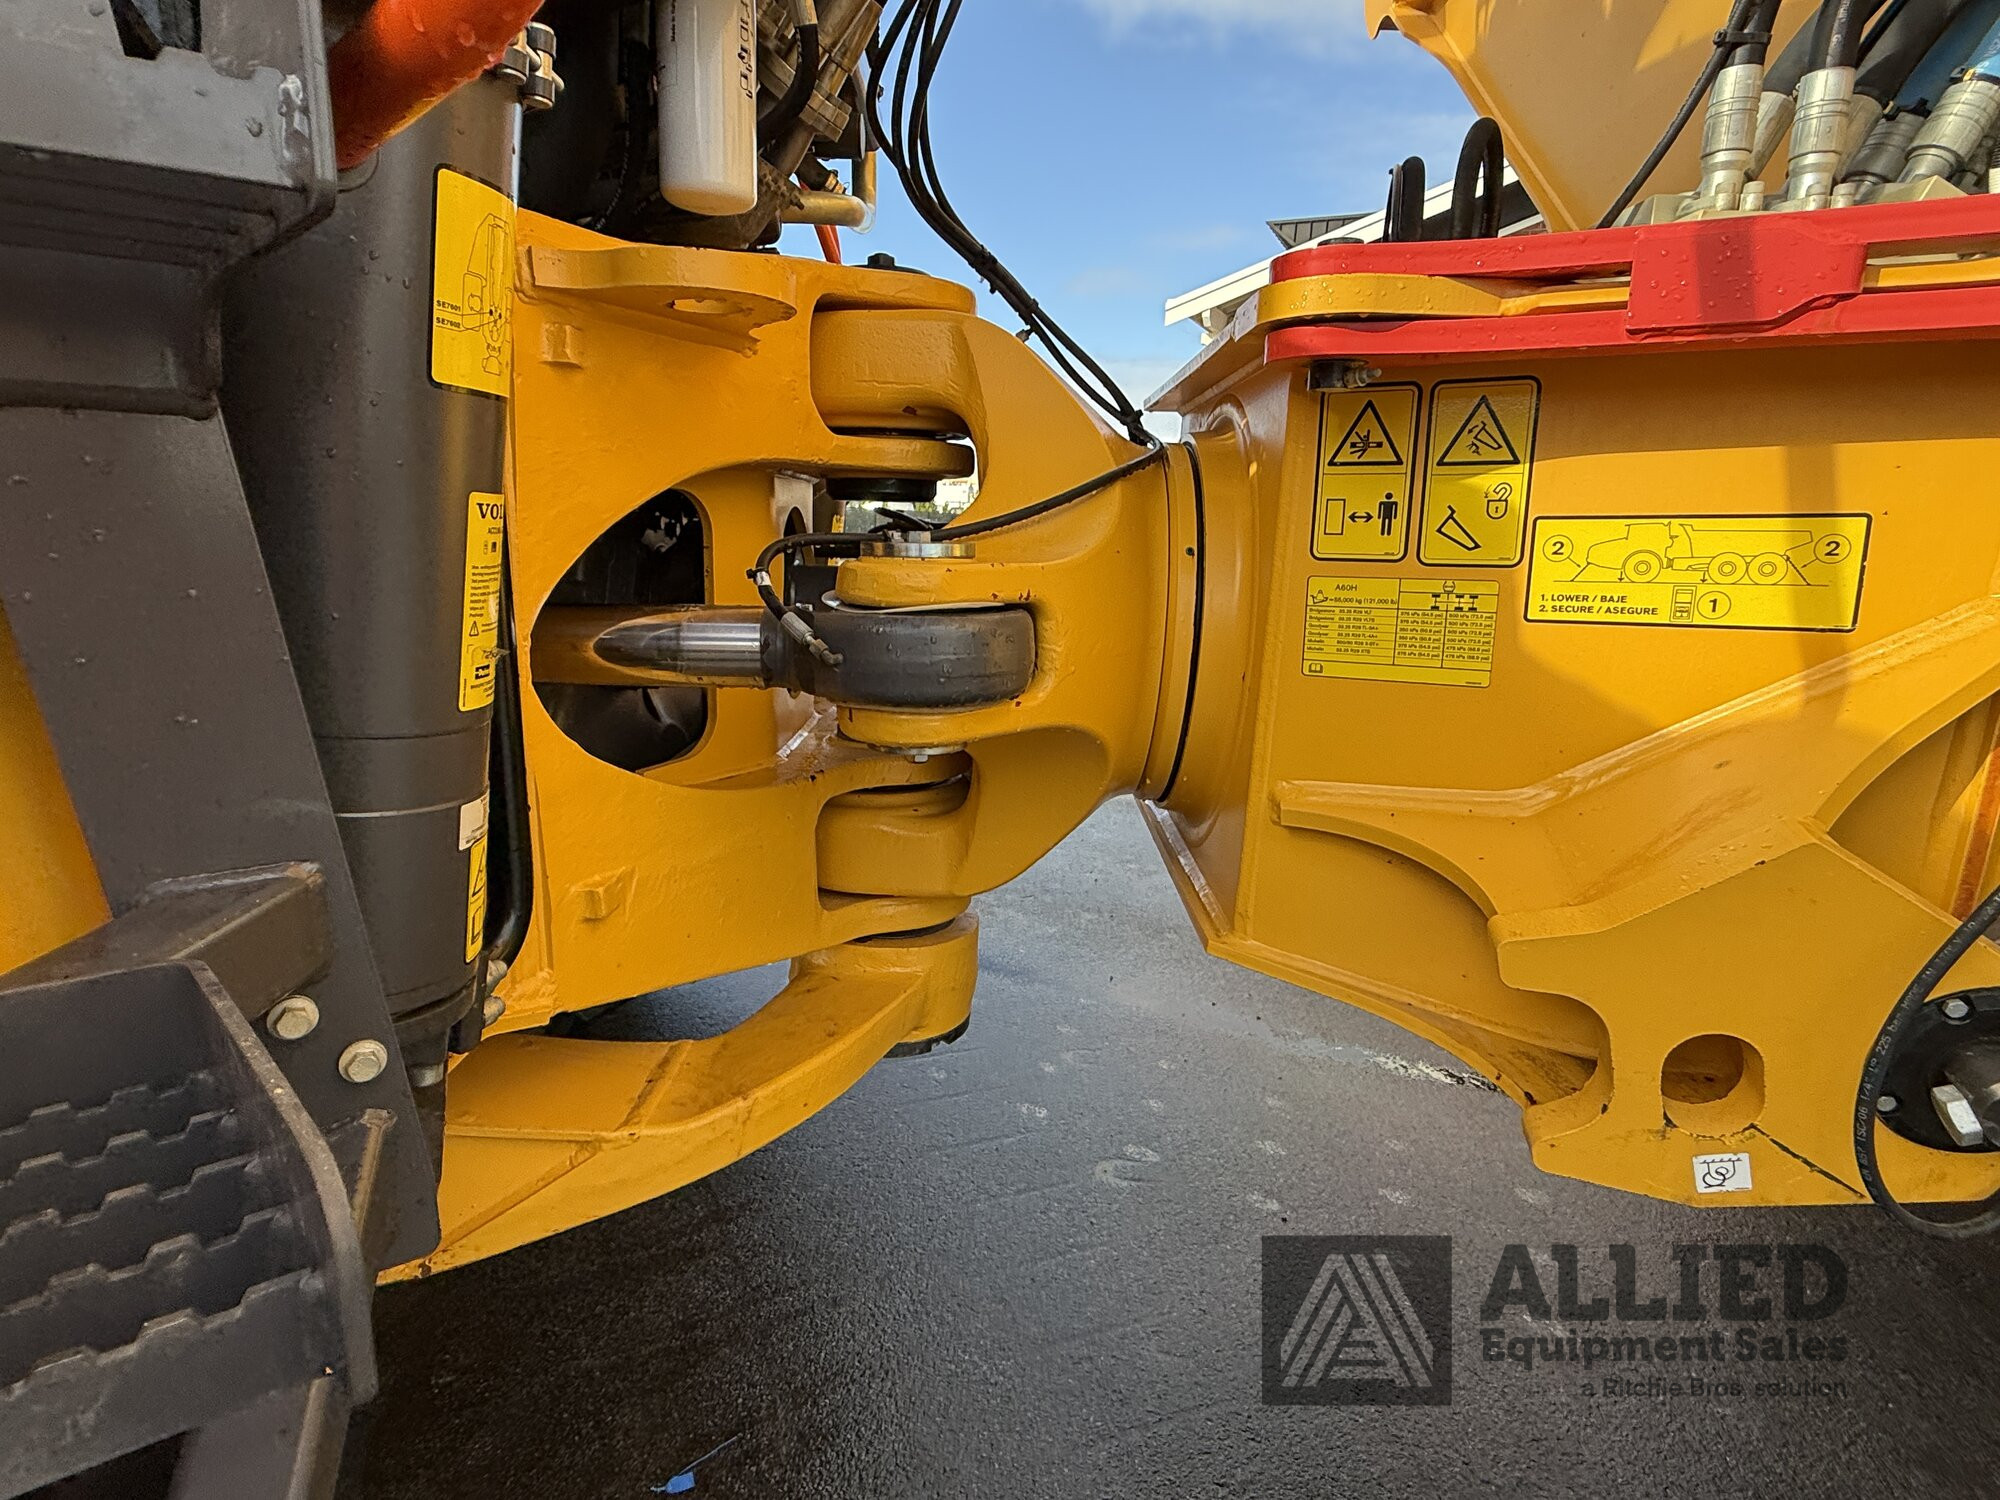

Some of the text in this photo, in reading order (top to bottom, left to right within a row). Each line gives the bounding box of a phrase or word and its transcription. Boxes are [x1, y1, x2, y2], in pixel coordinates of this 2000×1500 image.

[1552, 542, 1564, 556] 2
[1825, 541, 1840, 556] 2
[1551, 594, 1590, 602] LOWER
[1600, 595, 1628, 604] BAJE
[1709, 599, 1718, 613] 1
[1539, 604, 1548, 612] 2.
[1551, 605, 1594, 614] SECURE
[1604, 606, 1658, 615] ASEGURE
[1875, 1036, 1892, 1057] 225
